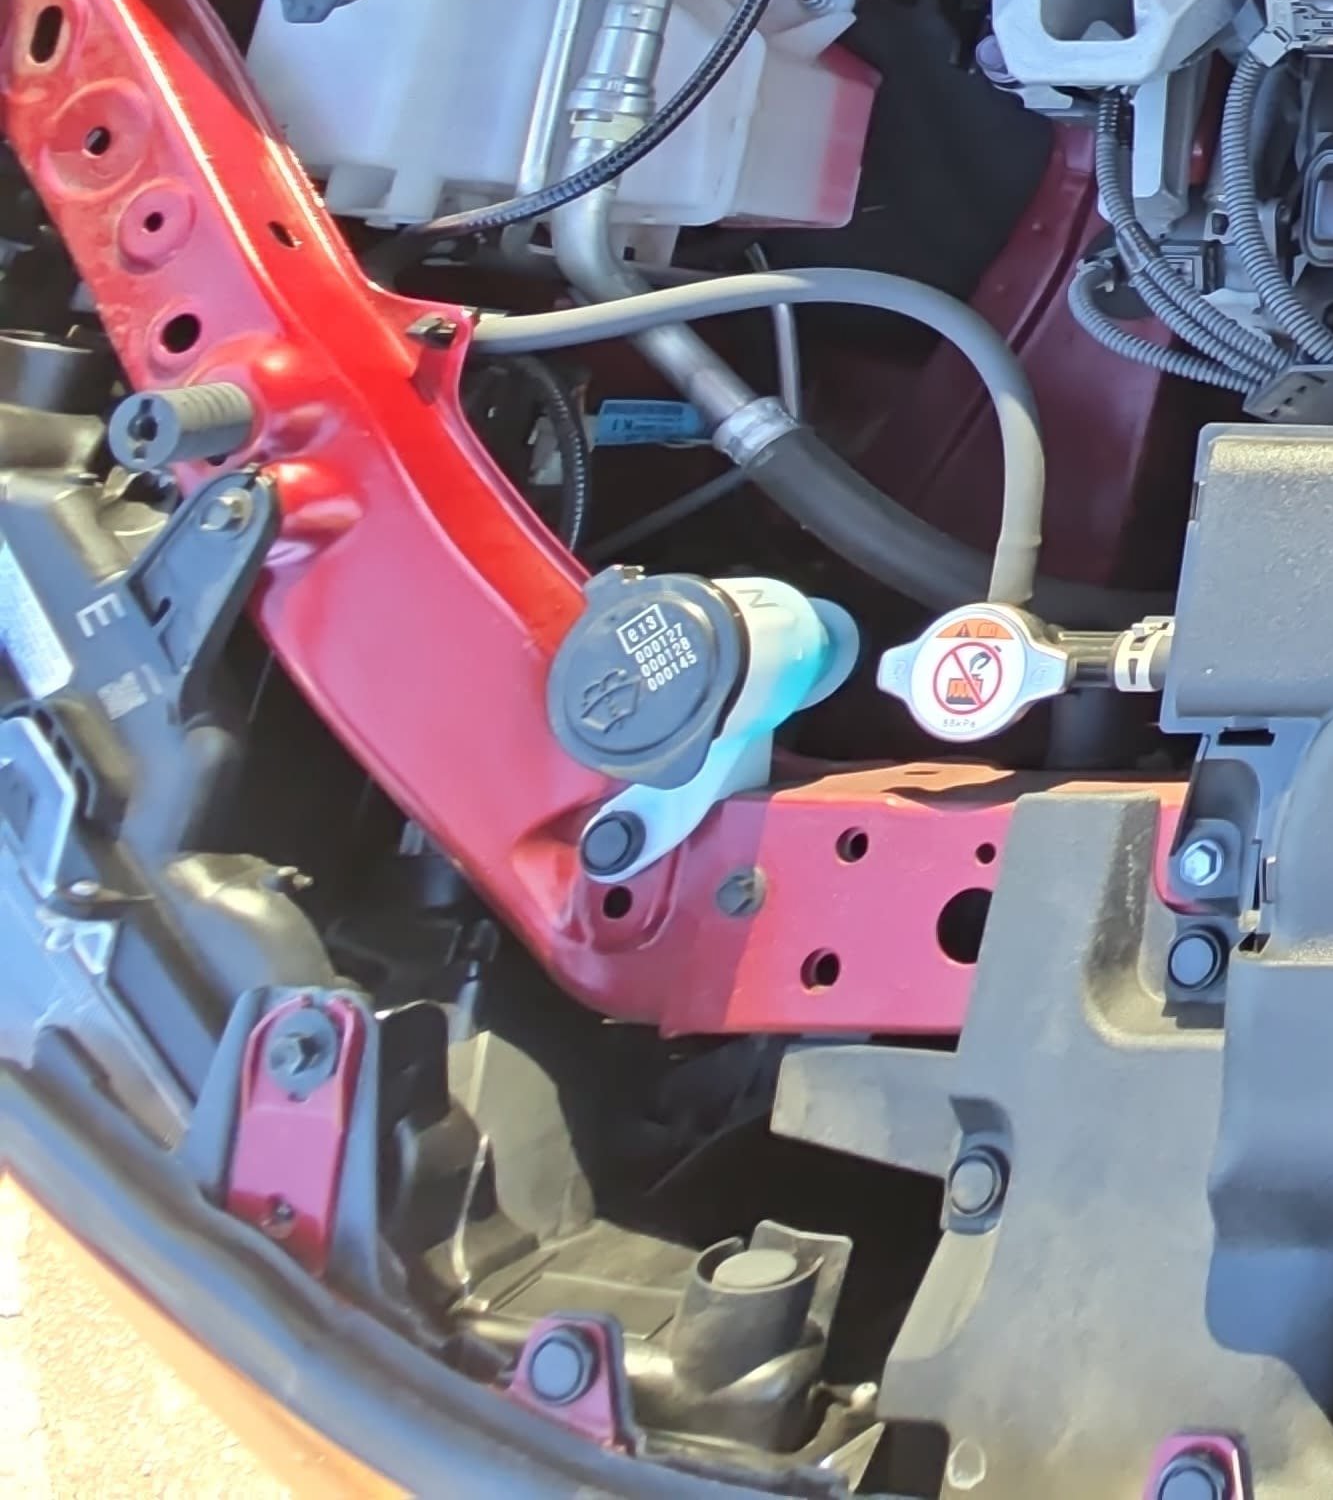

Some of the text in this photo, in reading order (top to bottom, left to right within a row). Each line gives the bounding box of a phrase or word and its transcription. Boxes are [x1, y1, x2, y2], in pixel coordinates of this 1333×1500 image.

[627, 615, 658, 643] e13
[634, 622, 683, 664] 000127
[640, 637, 691, 678] 000128
[647, 650, 698, 692] 000145
